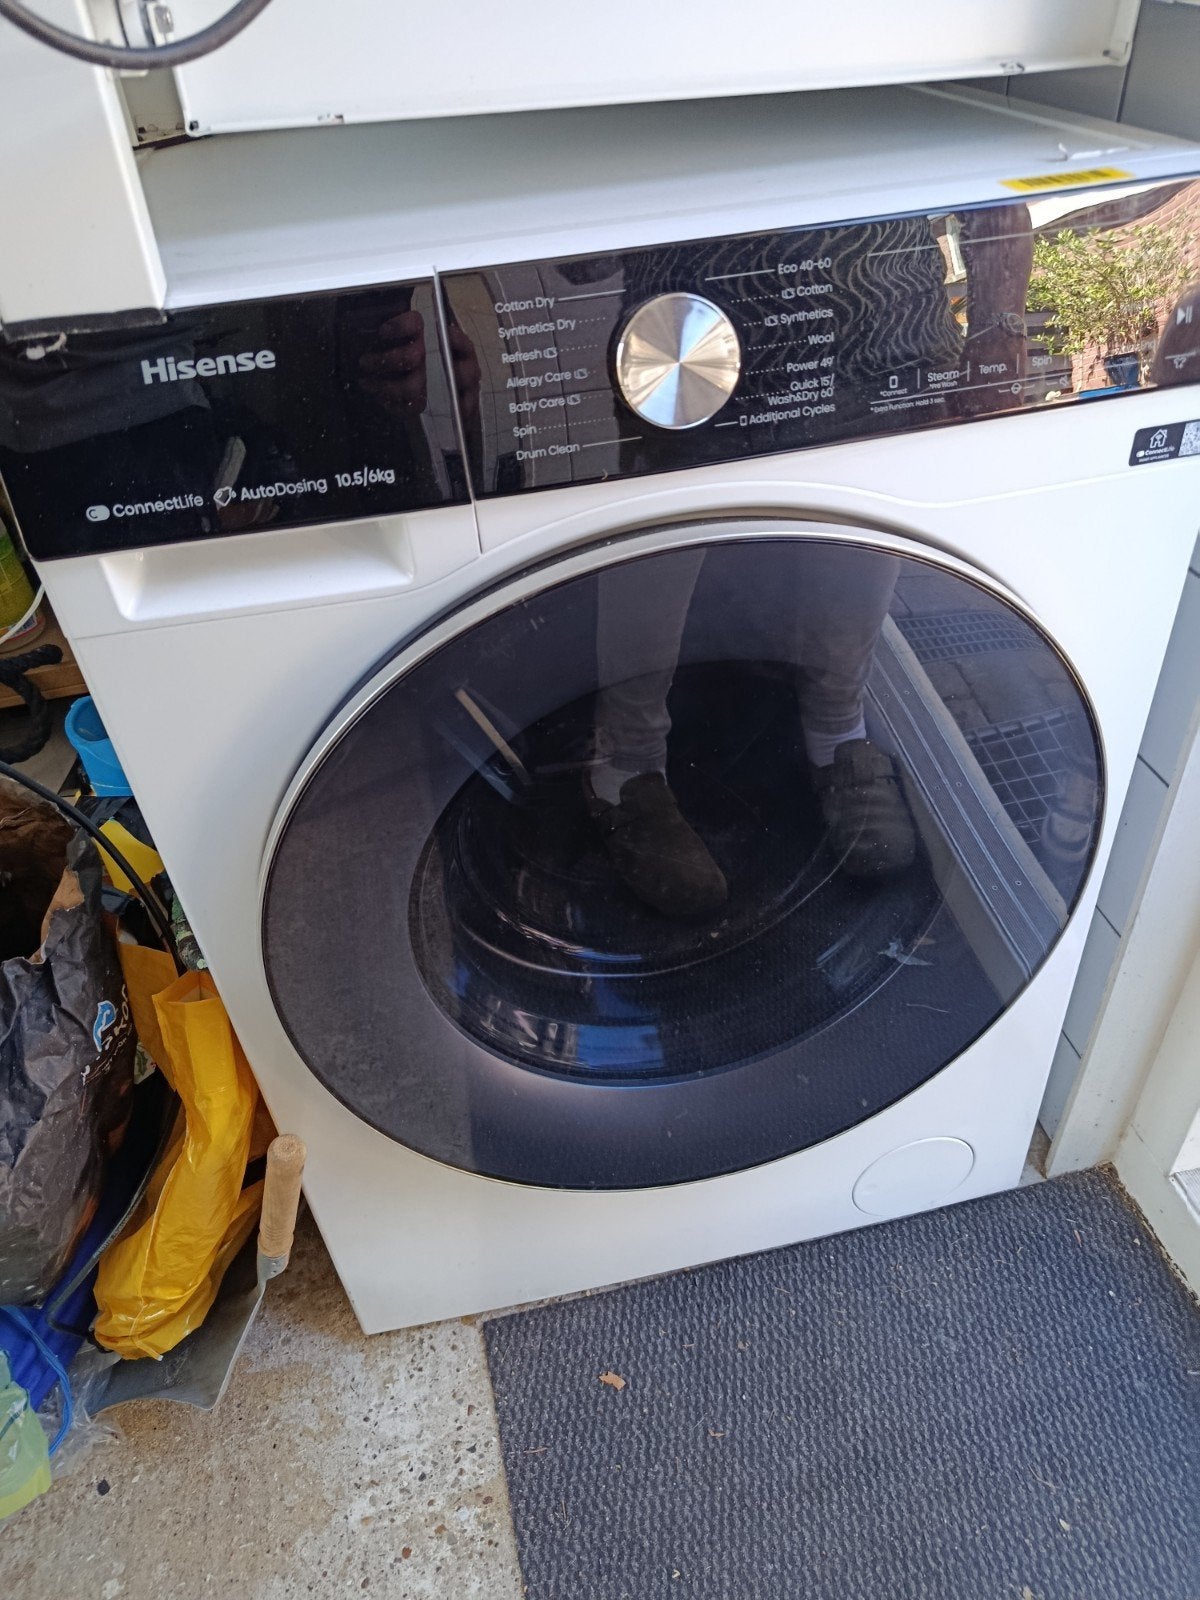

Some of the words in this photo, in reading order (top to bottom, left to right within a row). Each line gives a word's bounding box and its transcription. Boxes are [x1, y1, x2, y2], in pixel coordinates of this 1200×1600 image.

[777, 263, 798, 275] Eco
[799, 257, 832, 271] 40-60
[796, 283, 833, 297] Cotton
[494, 302, 534, 313] Cotton
[535, 297, 555, 309] Dry
[780, 308, 834, 326] Synthetics
[498, 321, 555, 340] Synthetics
[556, 318, 577, 331] Dry
[807, 331, 835, 346] Wool
[501, 348, 543, 364] Refresh
[1031, 353, 1053, 367] Spin
[140, 349, 276, 385] Hisense
[786, 360, 819, 373] Power
[979, 363, 1007, 375] Temp.
[506, 376, 543, 389] Allergy
[544, 371, 572, 383] Care
[927, 369, 960, 382] Steam
[790, 378, 819, 391] Quick
[508, 401, 537, 414] Baby
[538, 396, 566, 409] Care
[768, 391, 819, 406] Wash&Dry
[915, 399, 929, 407] Hold
[749, 408, 801, 425] Additional
[802, 403, 836, 418] Cycles
[512, 424, 538, 438] Spin
[515, 448, 547, 460] Drum
[548, 443, 580, 456] Clean
[111, 493, 204, 519] ConnectLife
[240, 477, 328, 502] AutoDosing
[334, 467, 396, 489] 10.5/6kg
